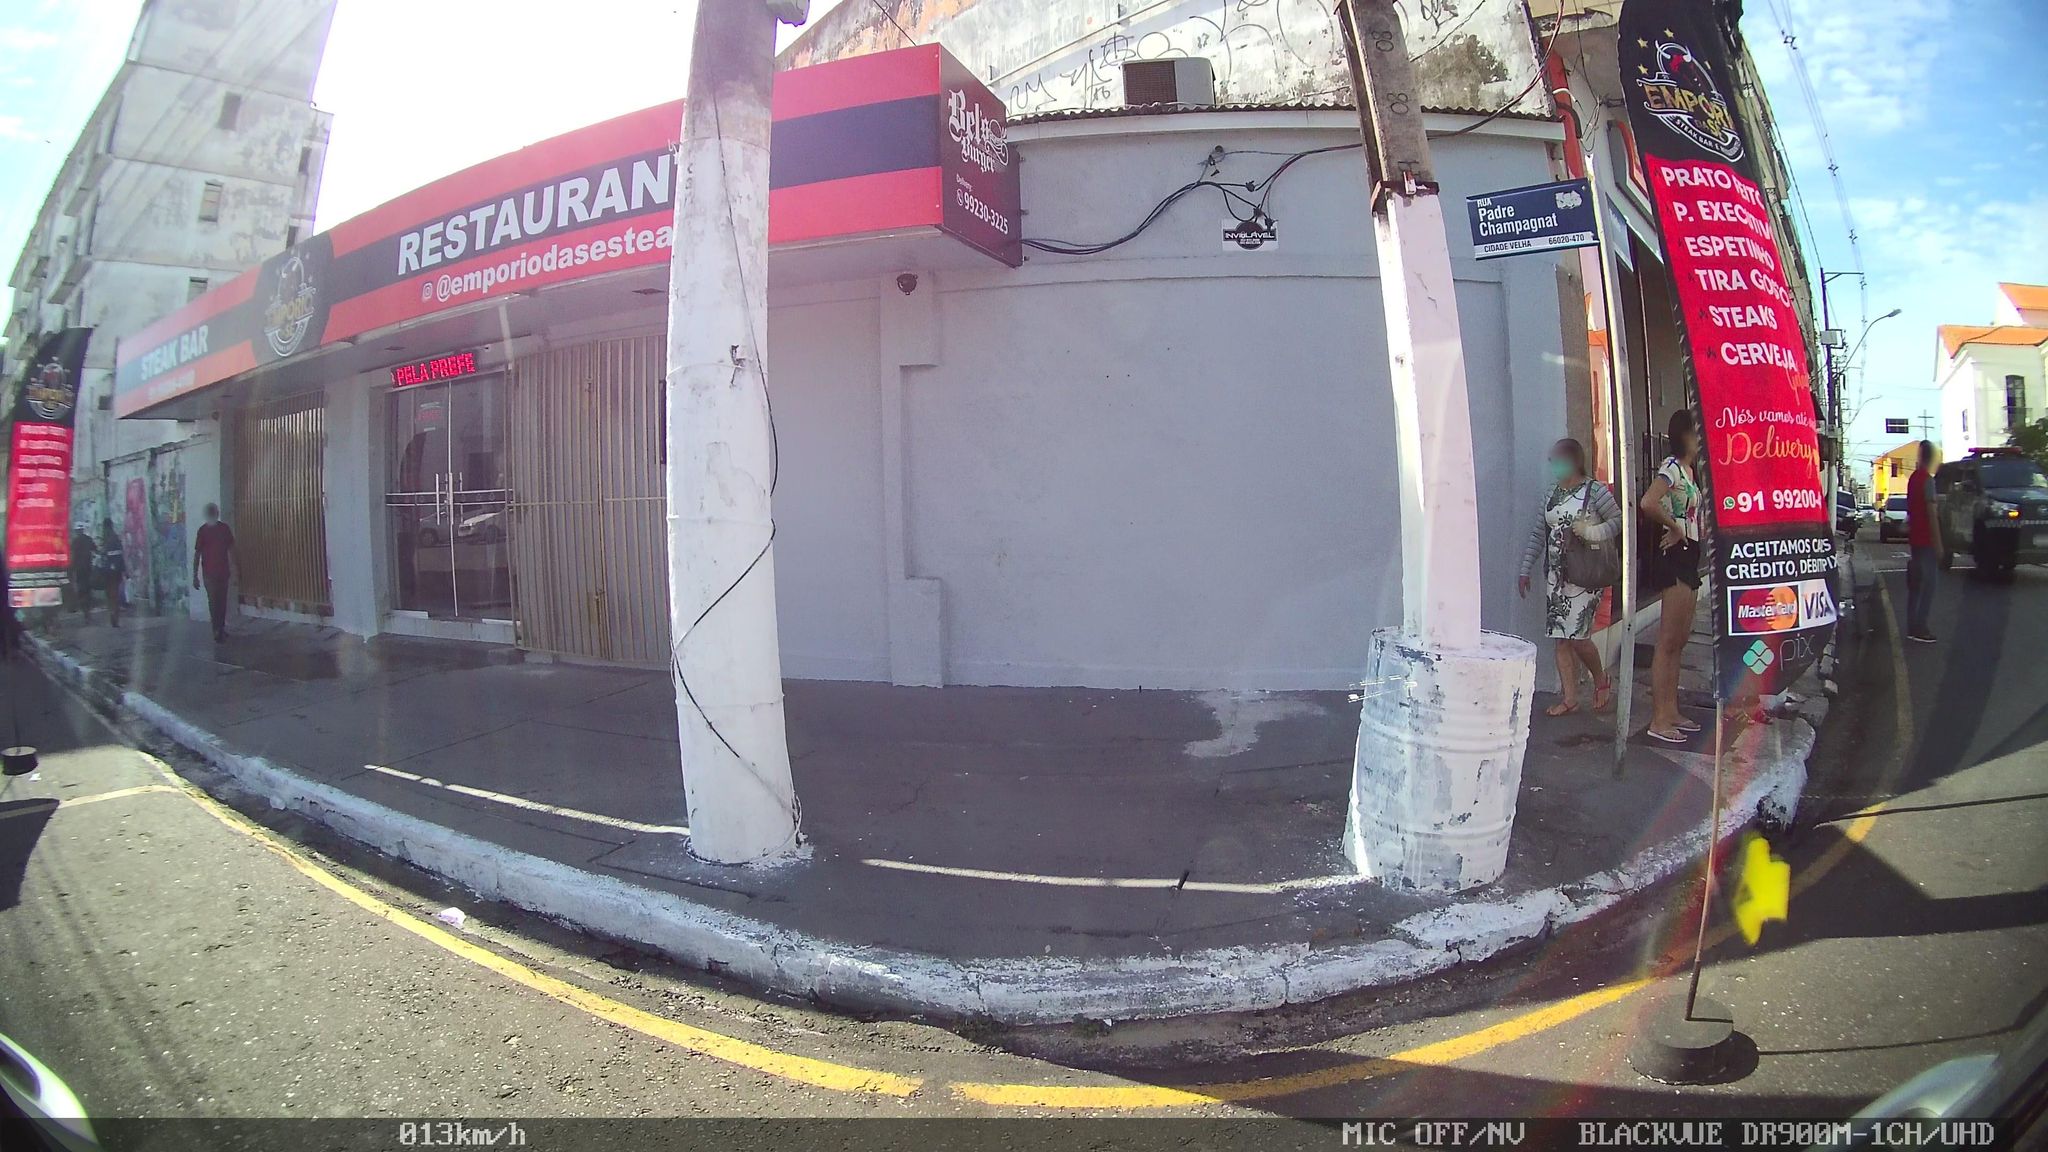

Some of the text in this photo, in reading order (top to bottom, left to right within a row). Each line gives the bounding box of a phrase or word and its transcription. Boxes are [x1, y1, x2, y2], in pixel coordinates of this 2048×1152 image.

[1661, 166, 1731, 189] PRATO
[397, 149, 679, 276] RESTAURAN
[964, 192, 1009, 235] 99230-3225
[1477, 198, 1492, 208] RUA
[1478, 204, 1515, 221] Padre
[1672, 201, 1695, 222] P.
[1480, 212, 1558, 237] Champagnat
[1484, 240, 1532, 253] CIDADE VELHA
[1548, 234, 1585, 245] 66020-470
[436, 225, 674, 303] @emporiodasestea
[1695, 269, 1748, 291] TIRA
[1708, 305, 1778, 330] STEAKS
[141, 324, 208, 381] STEAK BAR
[1721, 342, 1798, 372] CERVEJA
[1715, 406, 1757, 429] Nós
[1759, 410, 1794, 425] vamos
[1718, 424, 1813, 480] Delivery
[1737, 490, 1765, 513] 91
[1730, 538, 1811, 559] ACEITAMOS
[1725, 558, 1798, 580] CRÉDITO,
[1738, 601, 1797, 619] MasterCard
[1802, 591, 1835, 620] VISA
[1780, 634, 1815, 672] pix
